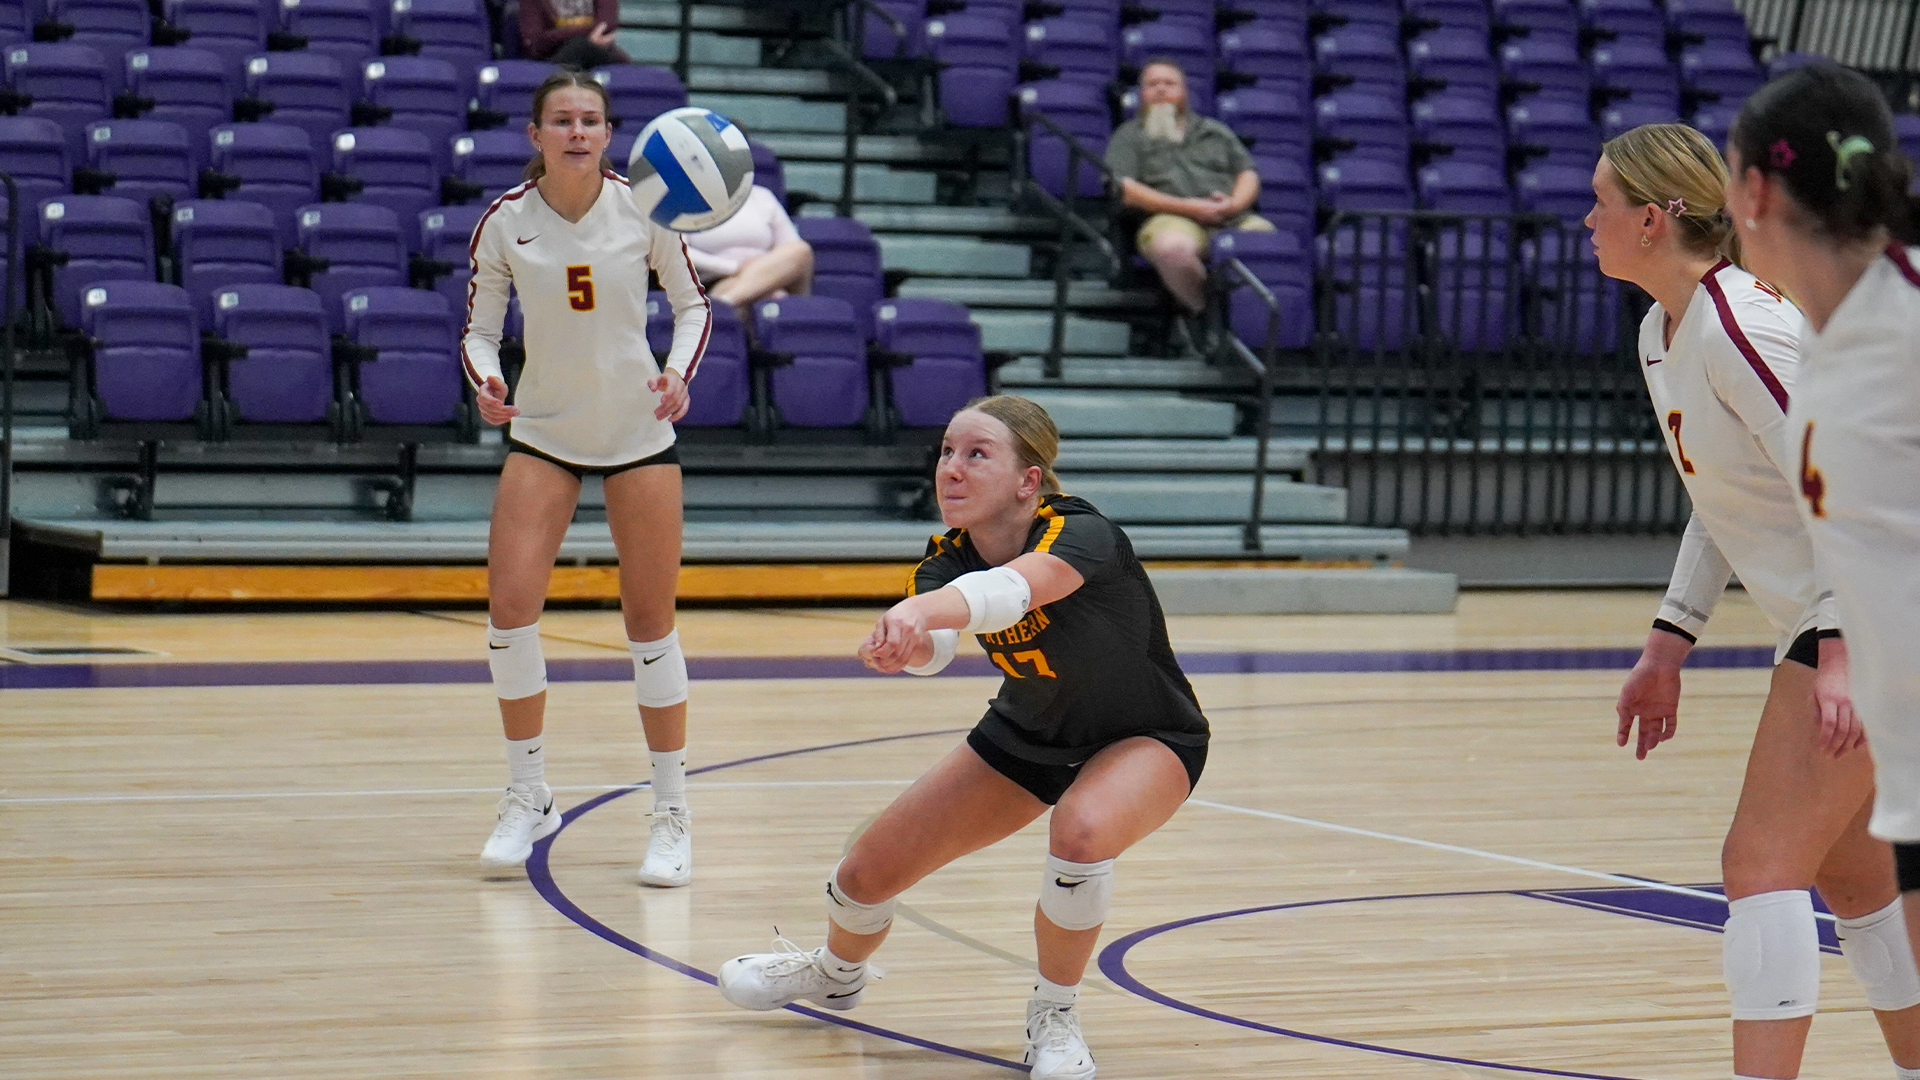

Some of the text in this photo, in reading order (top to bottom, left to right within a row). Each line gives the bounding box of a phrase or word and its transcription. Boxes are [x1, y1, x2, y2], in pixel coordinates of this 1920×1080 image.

[566, 264, 595, 312] 5
[1667, 410, 1696, 475] 2
[1800, 421, 1827, 517] 4
[991, 649, 1057, 679] 17
